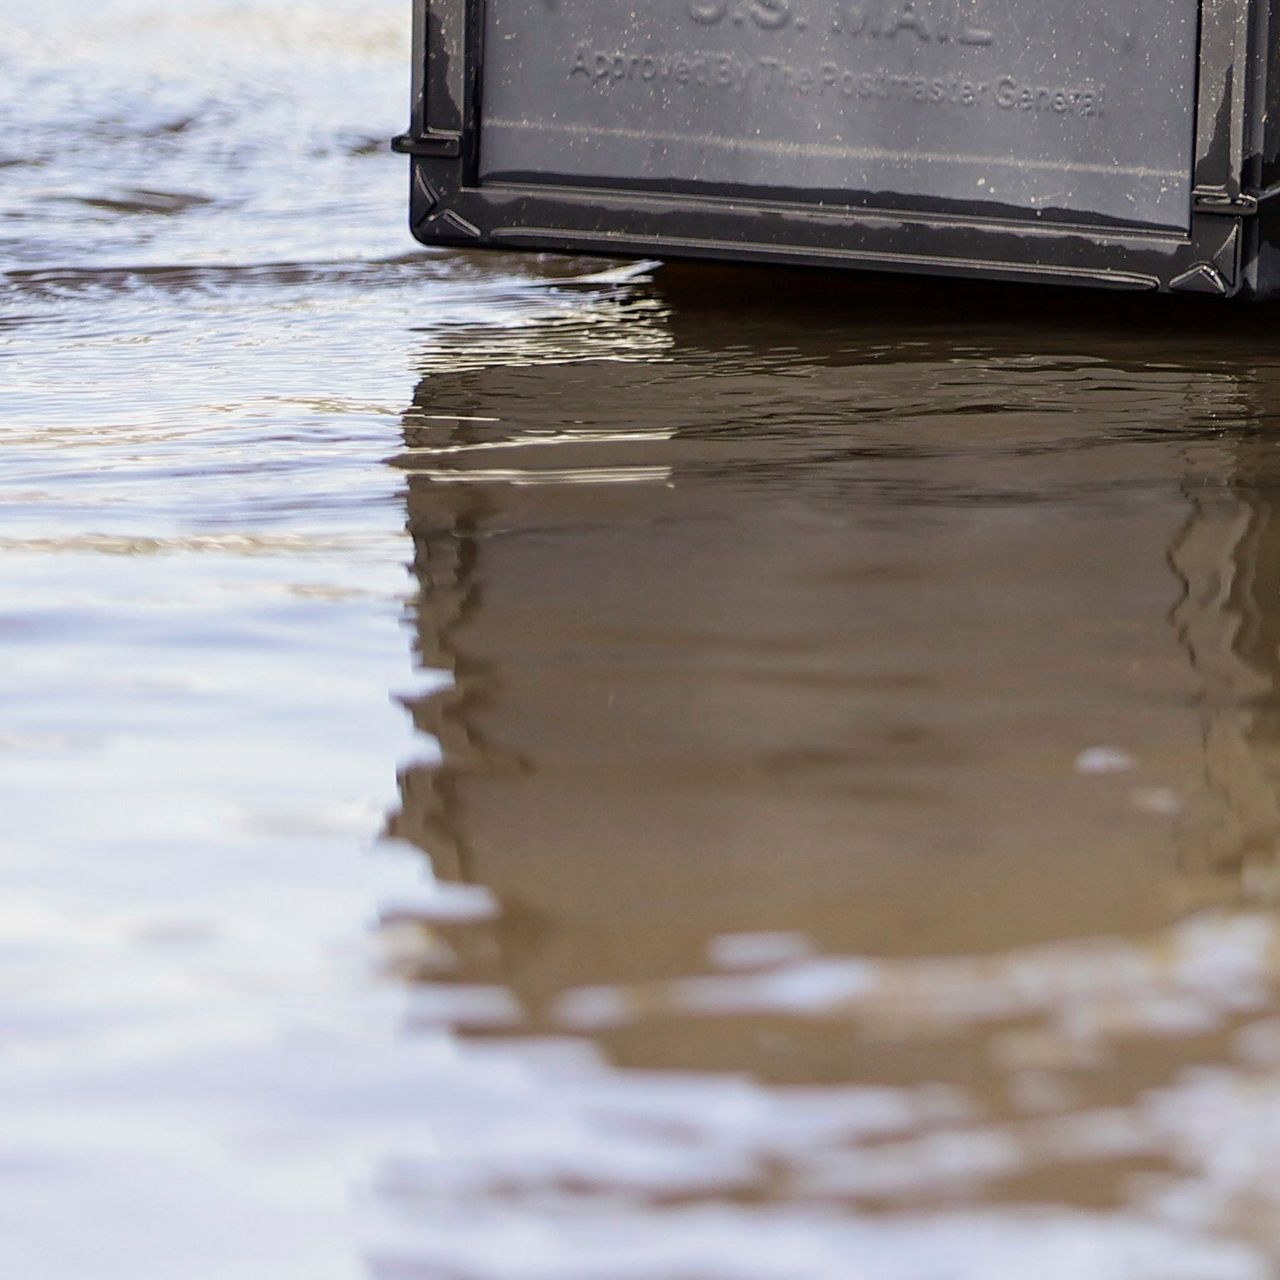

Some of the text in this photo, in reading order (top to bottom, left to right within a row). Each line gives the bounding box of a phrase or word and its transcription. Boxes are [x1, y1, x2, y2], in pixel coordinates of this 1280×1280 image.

[566, 40, 1105, 118] Approved By The Postmaster General
